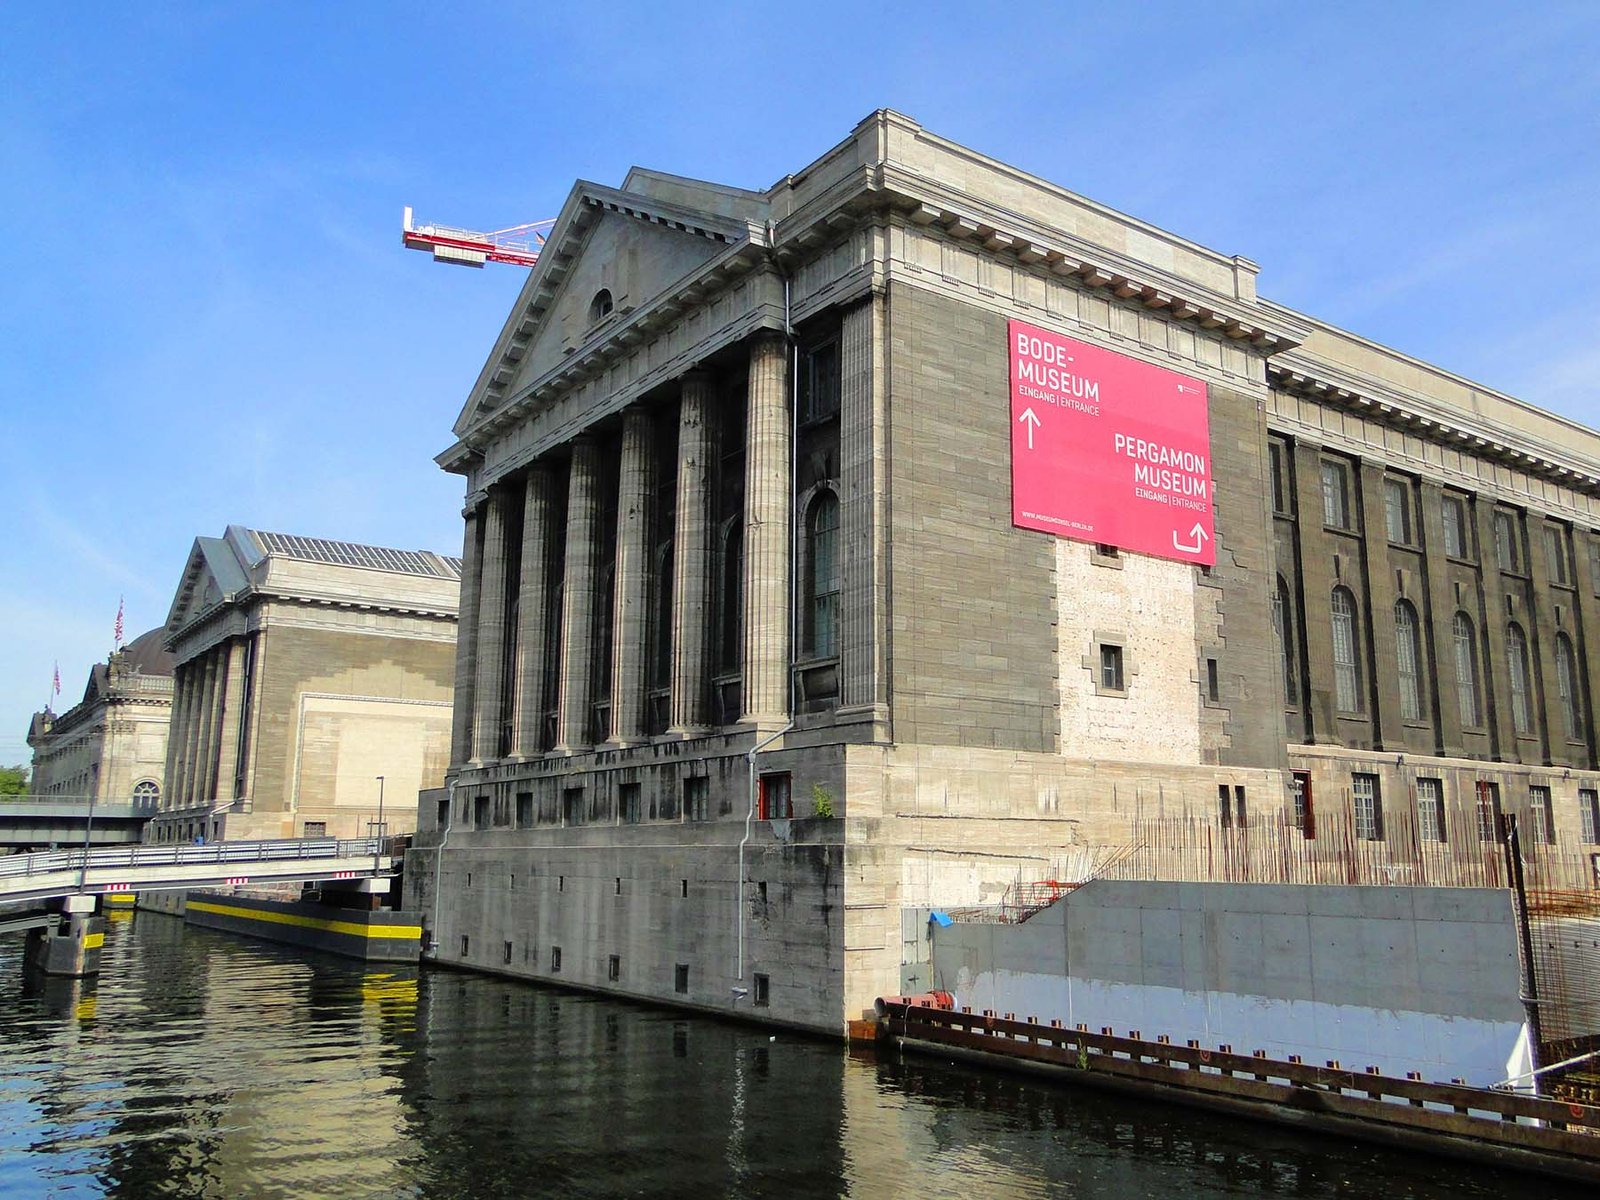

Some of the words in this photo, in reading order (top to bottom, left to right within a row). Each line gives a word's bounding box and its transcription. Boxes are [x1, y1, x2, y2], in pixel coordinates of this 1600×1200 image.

[1017, 332, 1074, 368] BODE-
[1018, 358, 1100, 403] MUSEUM
[1019, 384, 1055, 404] EINGANG
[1060, 396, 1100, 417] ENTRANCE
[1114, 433, 1205, 475] PERGAMON
[1134, 462, 1207, 499] MUSEUM
[1135, 487, 1168, 504] EINGANG
[1172, 496, 1207, 513] ENTRANCE
